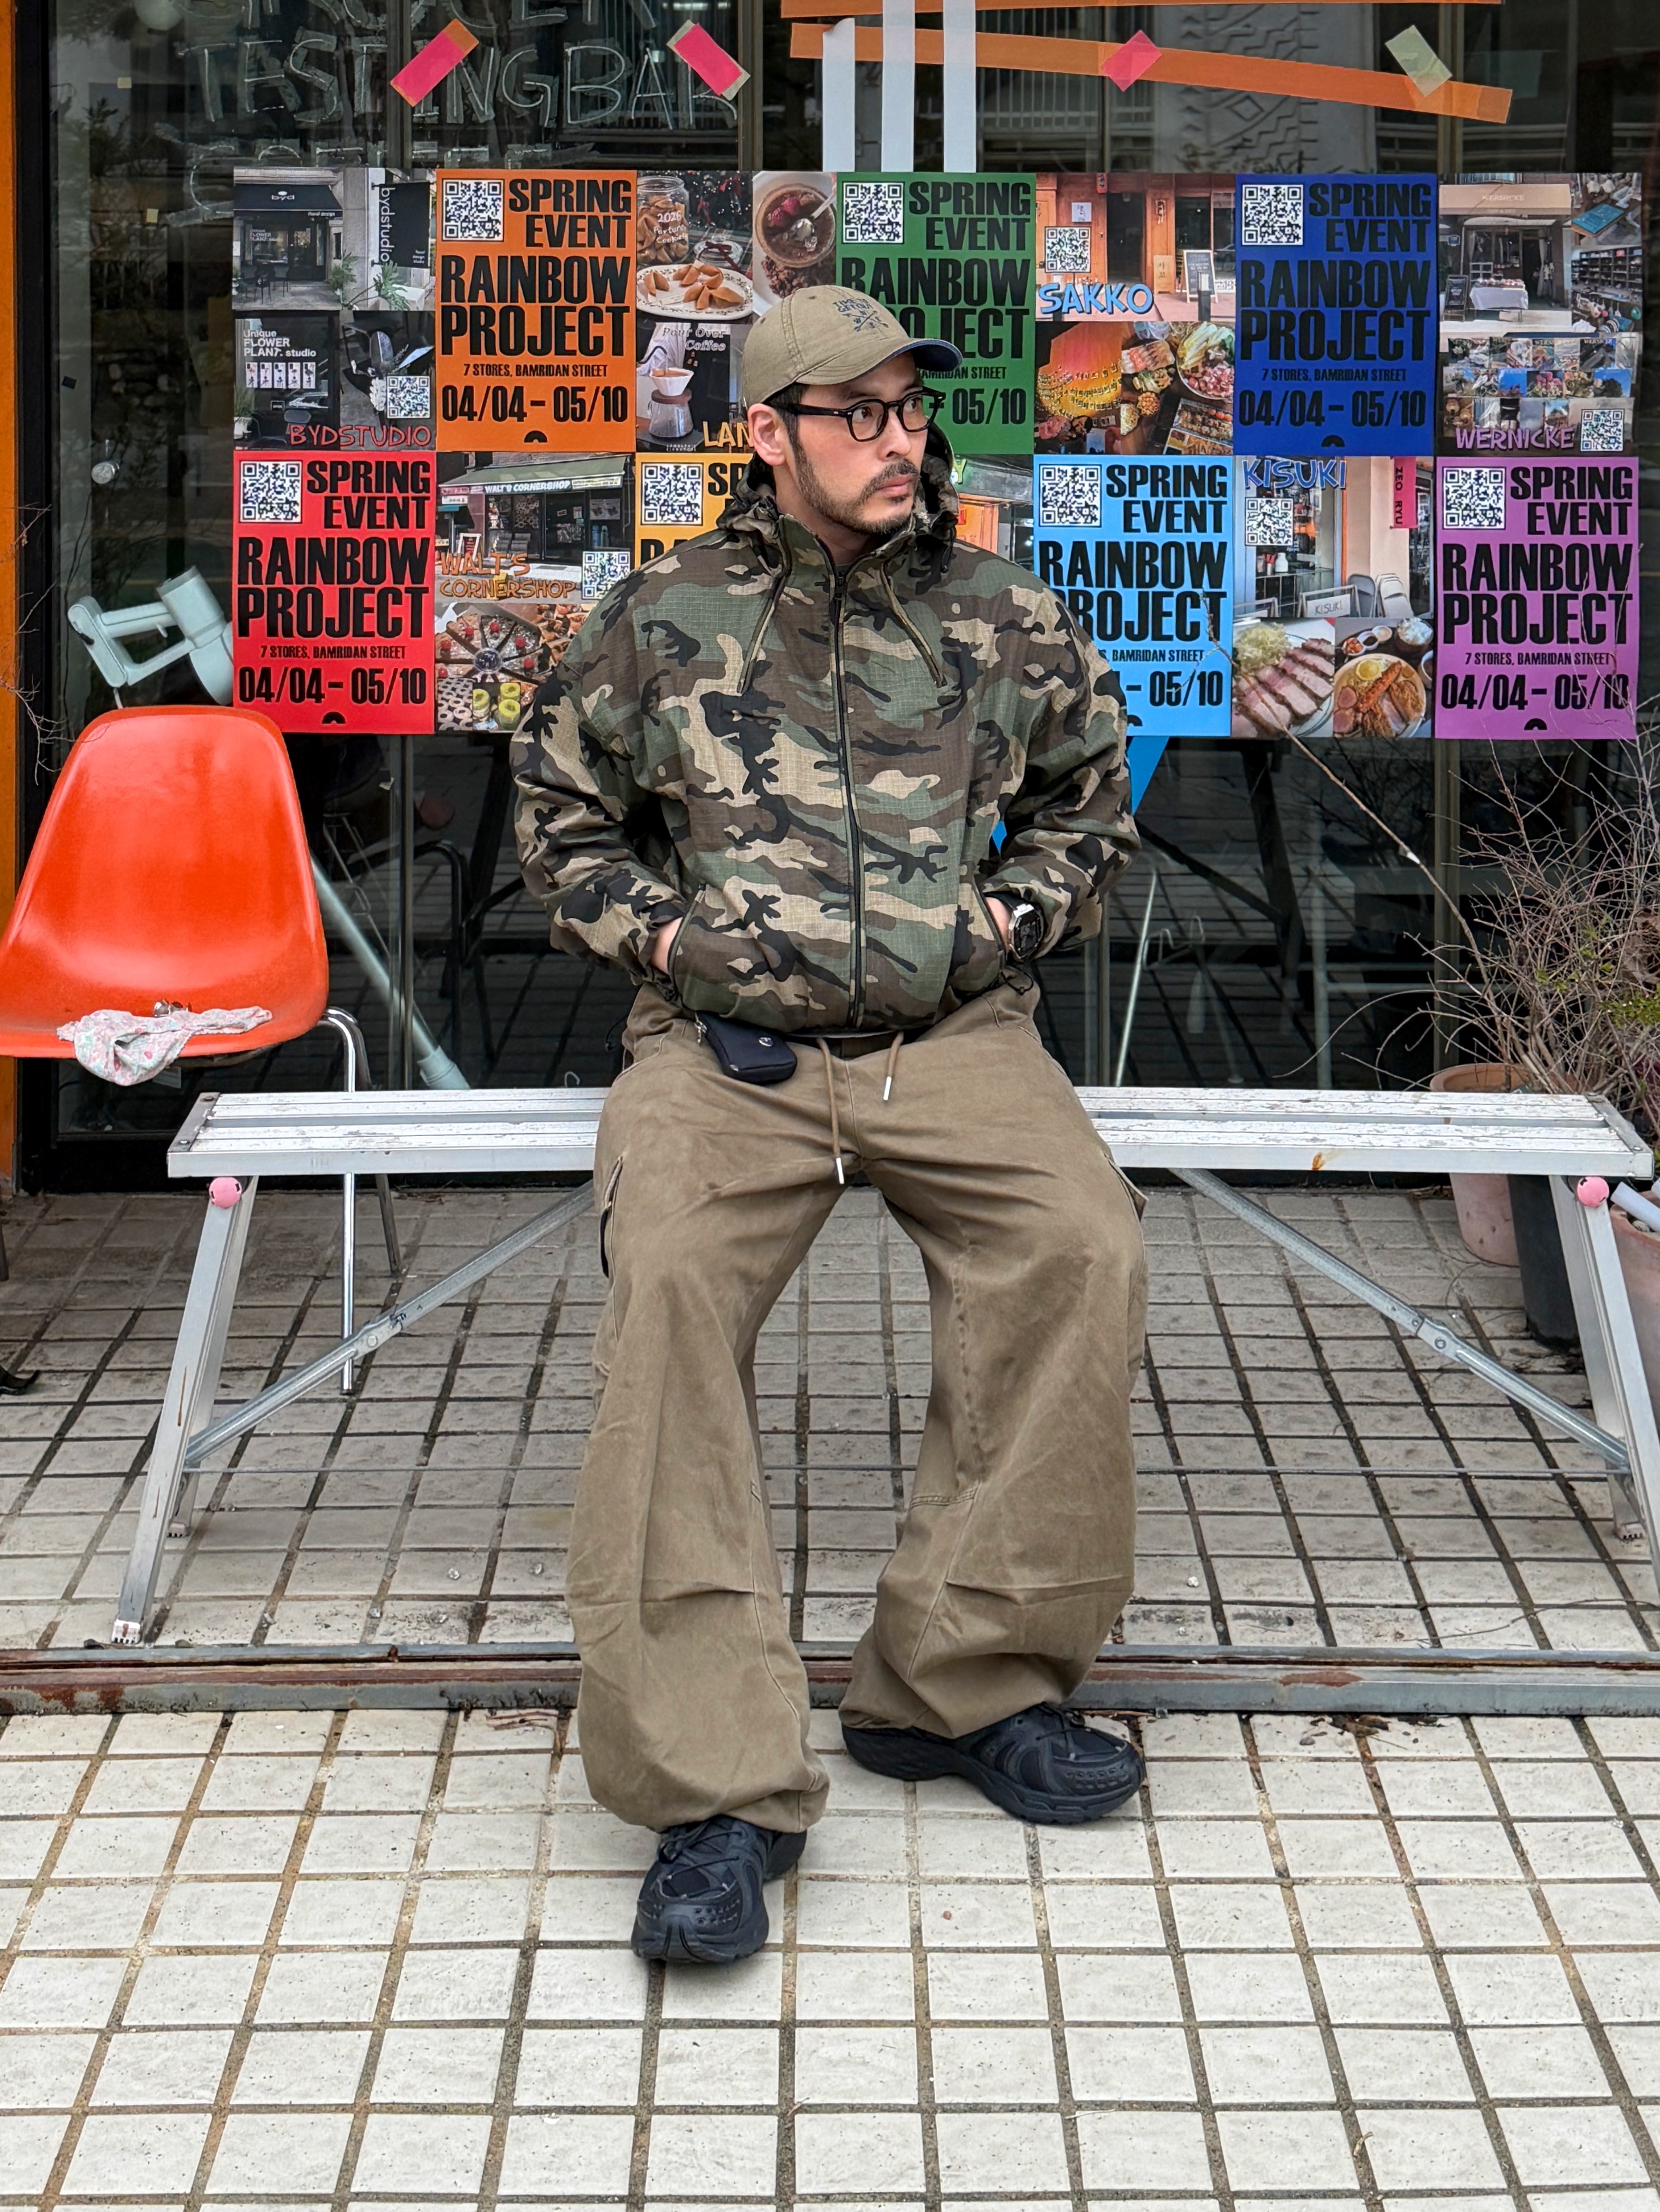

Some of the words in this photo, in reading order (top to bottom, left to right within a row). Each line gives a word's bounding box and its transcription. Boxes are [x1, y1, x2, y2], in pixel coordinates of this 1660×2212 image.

[509, 179, 631, 213] SPRING
[909, 182, 1030, 215] SPRING
[1309, 183, 1431, 216] SPRING
[380, 187, 396, 262] bydstudio
[526, 215, 631, 248] EVENT
[926, 217, 1030, 250] EVENT
[1326, 219, 1430, 252] EVENT
[441, 255, 630, 304] RAINBOW
[1240, 260, 1430, 308] RAINBOW
[1038, 282, 1154, 315] SAKKO
[243, 330, 277, 338] Unique
[244, 338, 290, 347] FLOWER
[441, 305, 630, 356] PROJECT
[662, 327, 693, 337] Pour
[695, 328, 726, 338] Over
[685, 340, 727, 351] Coffee
[1240, 310, 1430, 361] PROJECT
[286, 348, 317, 357] studio
[464, 364, 470, 376] 7
[516, 365, 569, 376] BAMRIDAN
[572, 365, 606, 377] STREET
[972, 367, 1006, 379] STREET
[1263, 369, 1268, 380] 7
[1314, 369, 1368, 380] BAMRIDAN
[1371, 369, 1406, 381] STREET
[554, 386, 627, 422] 05/10
[953, 388, 1026, 424] 05/10
[1352, 390, 1426, 426] 05/10
[289, 424, 431, 447] BYDSTUDIO
[1455, 427, 1576, 451] WERNICKE
[307, 461, 430, 493] SPRING
[513, 480, 570, 492] CORNERSHOP
[1106, 465, 1227, 498] SPRING
[1242, 459, 1347, 489] KISUKI
[1511, 467, 1632, 500] SPRING
[324, 496, 430, 529] EVENT
[1123, 500, 1227, 533] EVENT
[1528, 502, 1632, 535] EVENT
[238, 537, 430, 585] RAINBOW
[1039, 541, 1227, 589] RAINBOW
[1443, 544, 1633, 591] RAINBOW
[440, 578, 576, 599] CORNERSHOP
[238, 587, 429, 638] PROJECT
[1444, 593, 1633, 644] PROJECT
[261, 645, 267, 657] 7
[314, 646, 367, 658] BAMRIDAN
[370, 646, 405, 659] STREET
[1113, 650, 1165, 661] BAMRIDAN
[1169, 650, 1203, 661] STREET
[1466, 653, 1472, 664] 7
[1518, 653, 1571, 664] BAMRIDAN
[1574, 653, 1611, 664] STREET
[352, 668, 426, 704] 05/10
[1150, 671, 1222, 706] 05/10
[1554, 674, 1629, 710] 05/10
